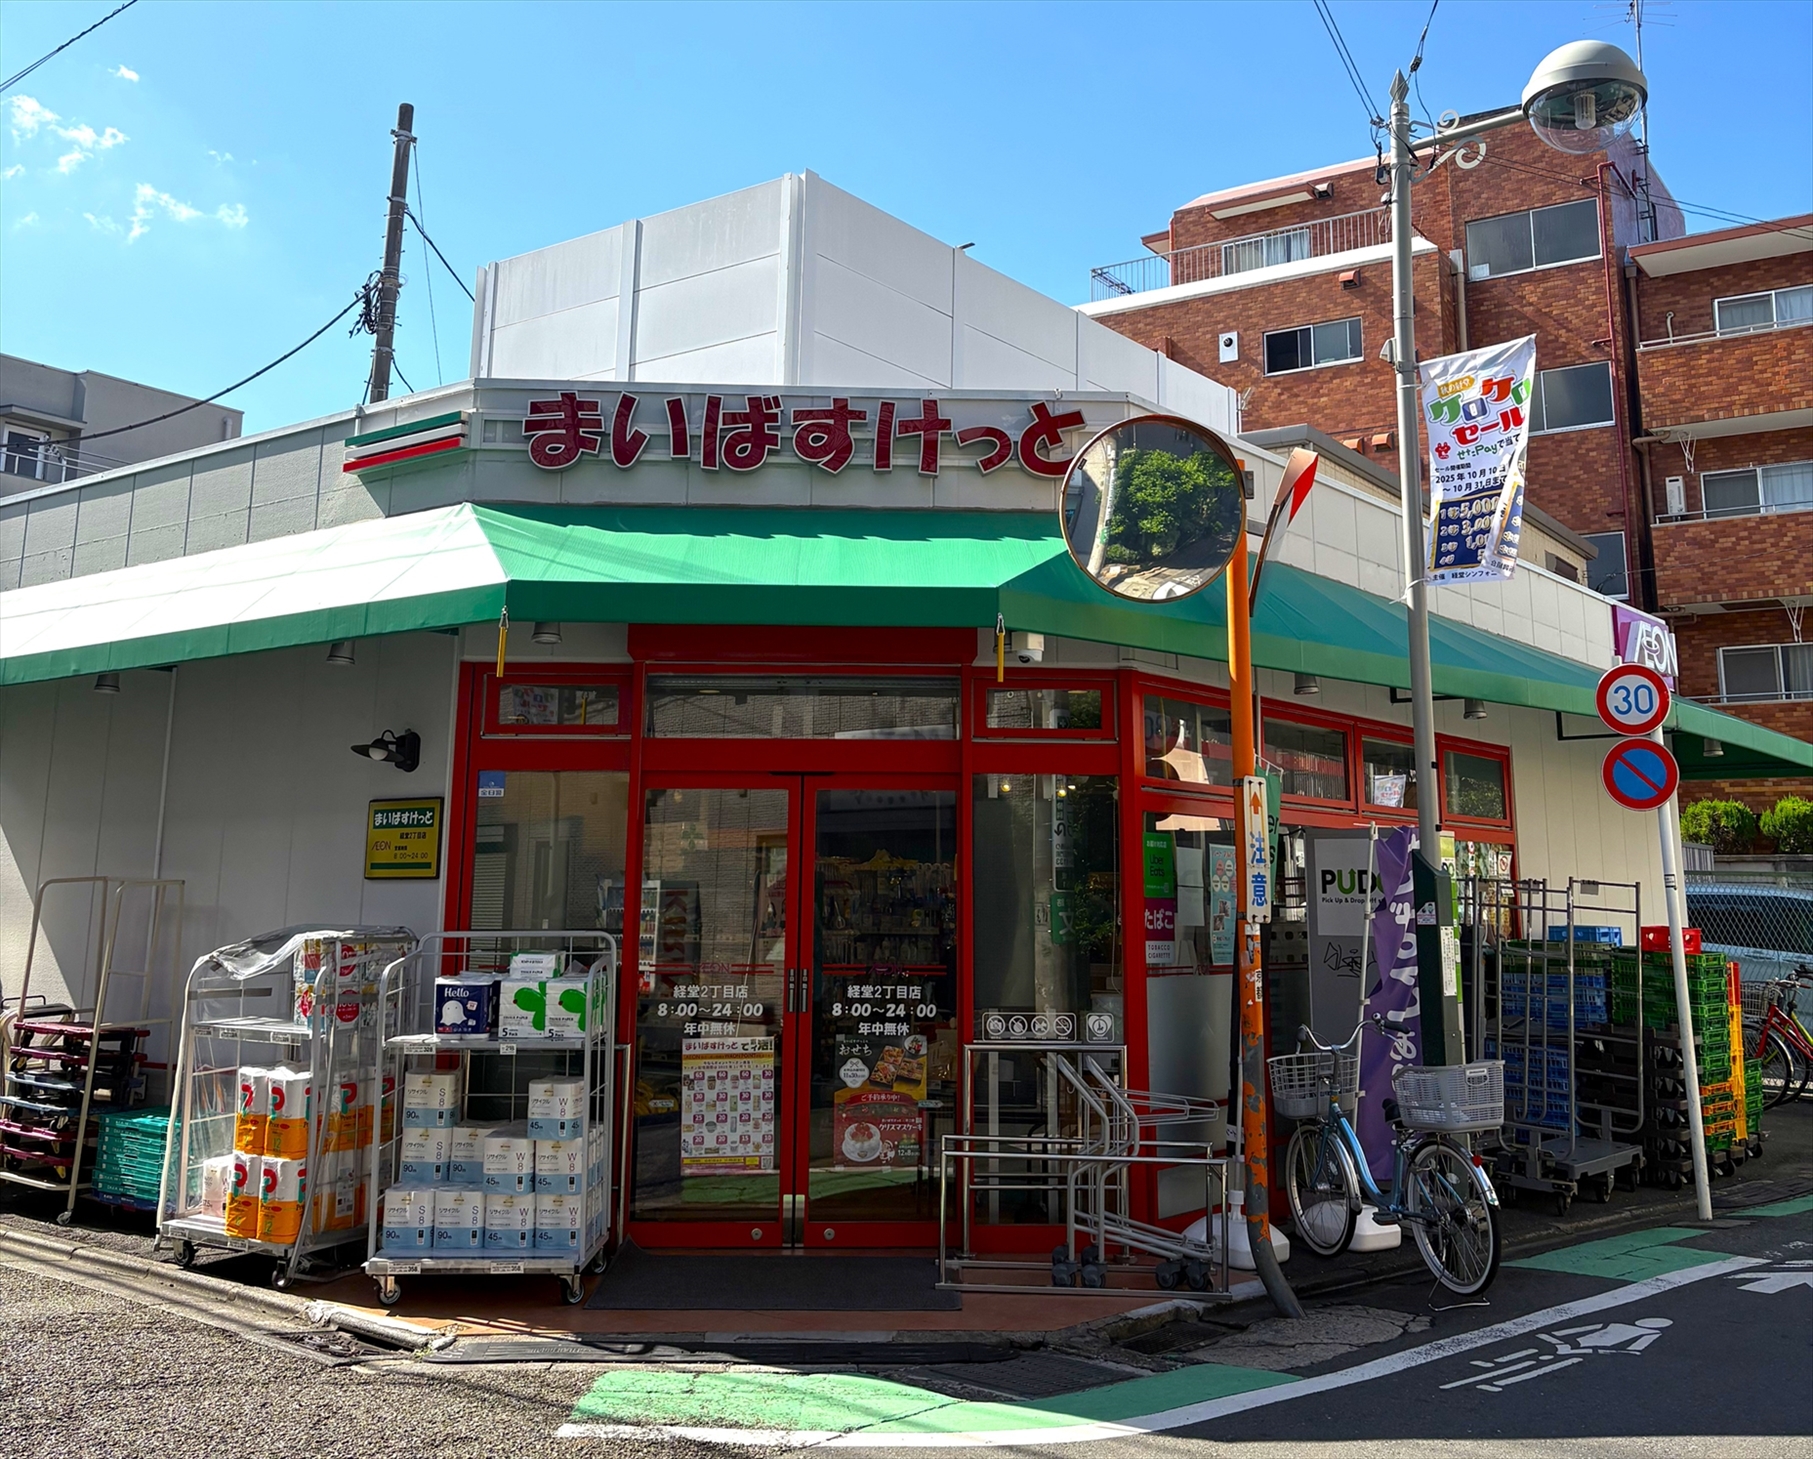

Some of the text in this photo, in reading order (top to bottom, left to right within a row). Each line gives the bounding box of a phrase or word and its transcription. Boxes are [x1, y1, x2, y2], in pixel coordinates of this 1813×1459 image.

[1452, 406, 1525, 445] セール
[522, 390, 1087, 478] まいばすけっと
[1613, 684, 1654, 715] 30
[375, 811, 433, 826] まいばすけっと
[1150, 854, 1164, 865] Uber
[1150, 866, 1165, 877] Eats
[1249, 831, 1268, 907] 注意
[1145, 908, 1174, 929] たばこ
[444, 987, 470, 998] Hello
[674, 985, 748, 999] 経堂2丁目店
[847, 985, 922, 999] 経堂2丁目店
[502, 1028, 508, 1037] 5
[548, 1029, 555, 1037] 5
[683, 1021, 735, 1036] 年中無休
[858, 1021, 910, 1036] 年中無休
[685, 1042, 738, 1051] まいばすけっと
[839, 1043, 873, 1056] おせち
[439, 1088, 446, 1097] S
[439, 1098, 445, 1107] 8
[559, 1098, 568, 1106] W
[560, 1107, 566, 1116] 8
[879, 1123, 923, 1131] クリスマスケーキ
[436, 1141, 443, 1150] S
[436, 1151, 442, 1160] 8
[516, 1152, 526, 1161] W
[567, 1152, 577, 1161] W
[517, 1162, 524, 1171] 8
[568, 1162, 575, 1171] 8
[418, 1205, 426, 1215] S
[471, 1205, 479, 1215] S
[519, 1207, 529, 1217] W
[568, 1207, 579, 1216] W
[418, 1216, 425, 1225] 8
[471, 1216, 478, 1225] 8
[520, 1218, 527, 1227] 8
[570, 1217, 577, 1226] 8
